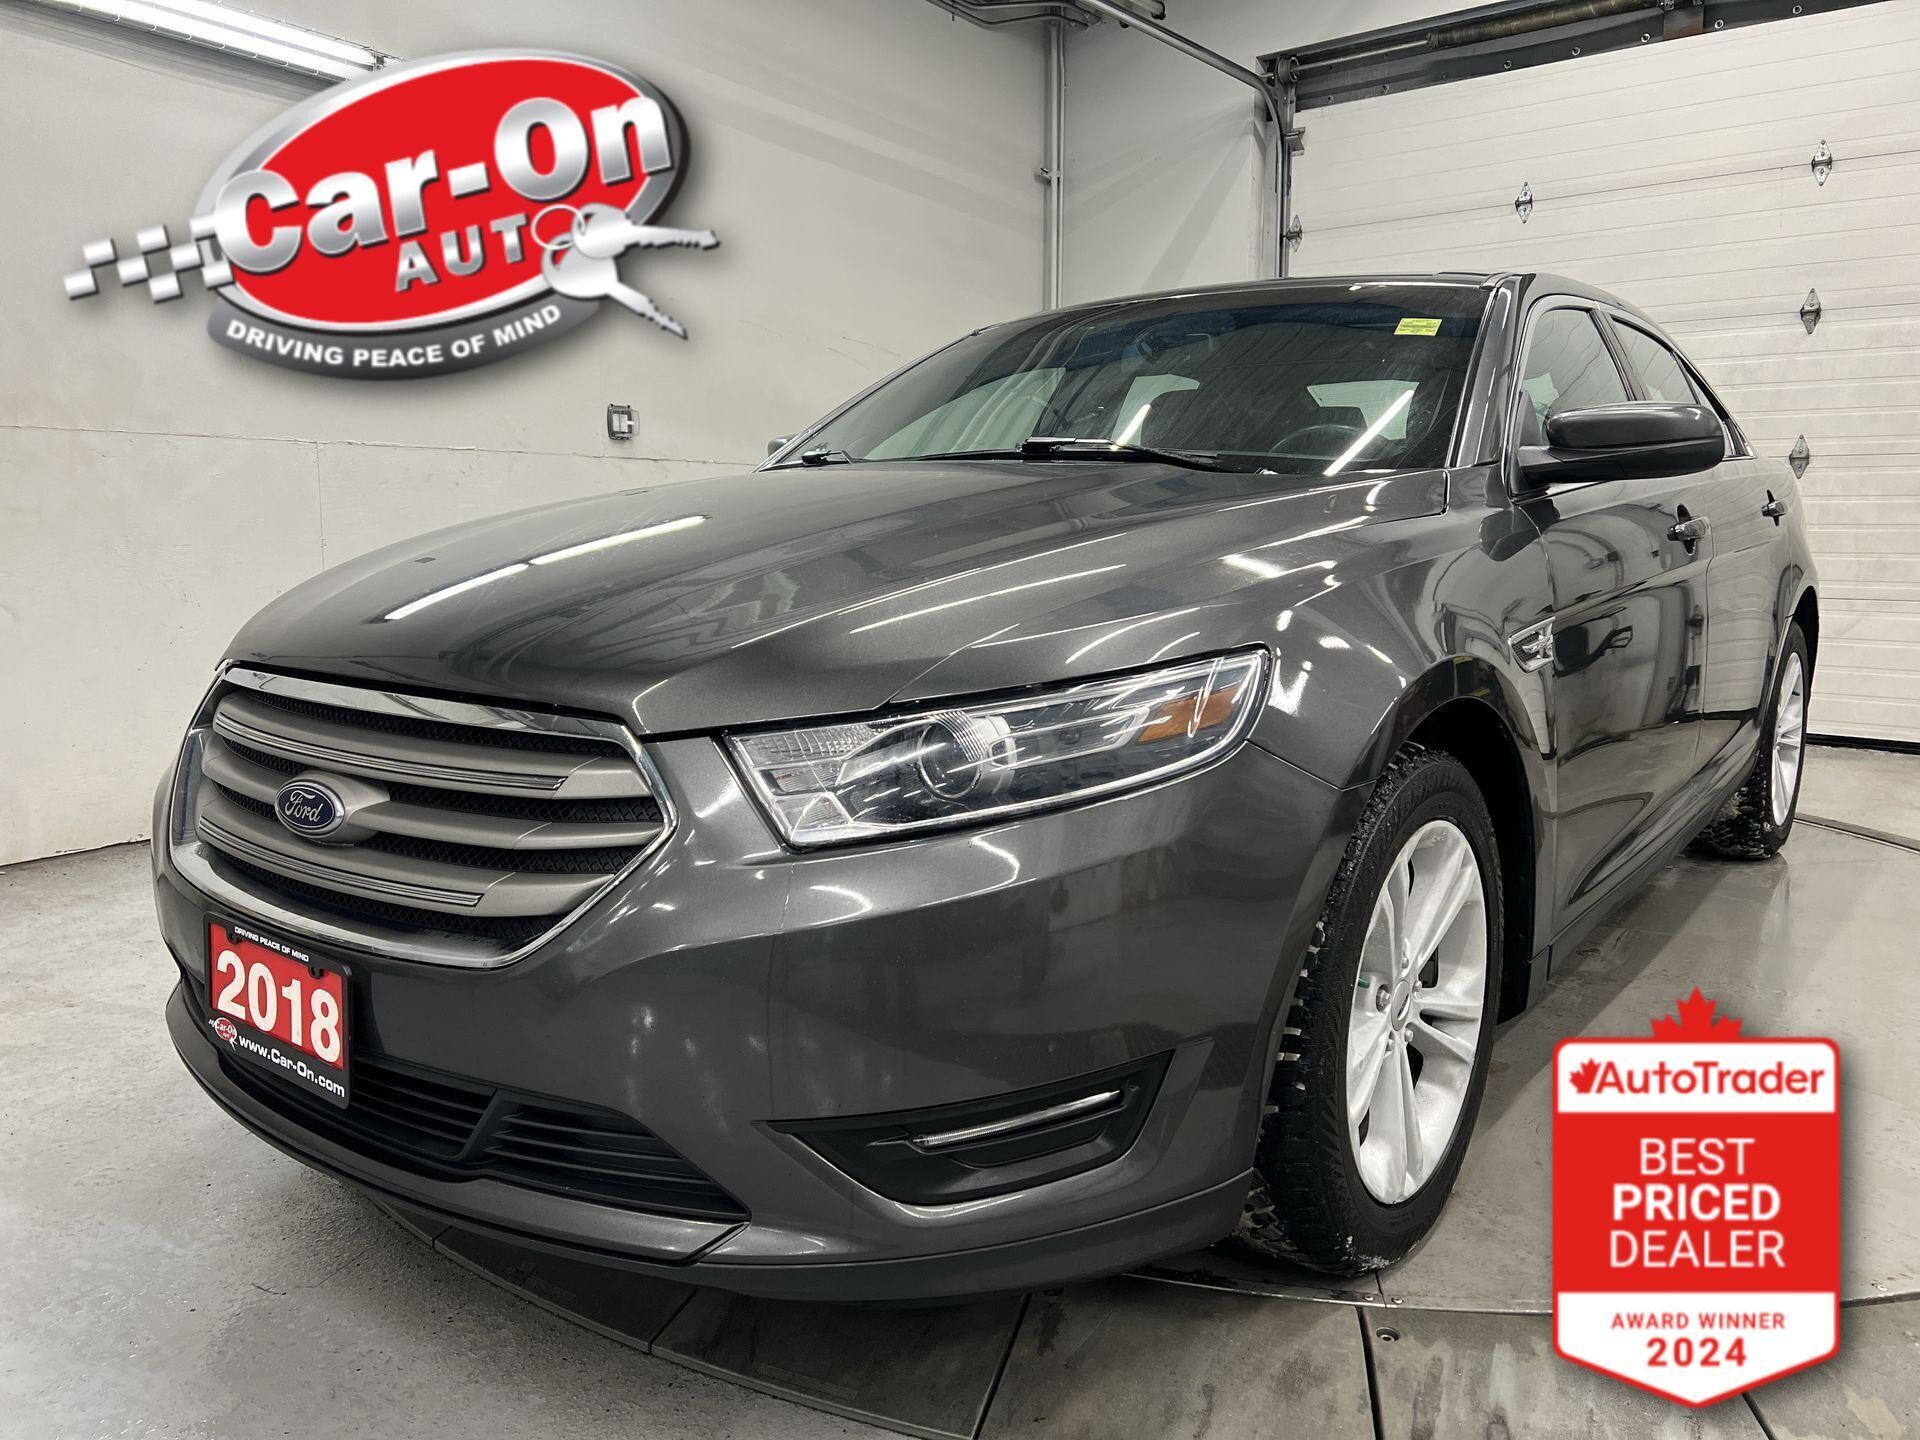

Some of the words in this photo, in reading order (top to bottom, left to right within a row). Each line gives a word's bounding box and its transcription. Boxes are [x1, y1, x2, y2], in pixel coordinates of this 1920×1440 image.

[284, 789, 324, 823] Ford
[234, 926, 260, 943] DRIVING
[260, 936, 281, 951] PEACE
[281, 945, 292, 955] OF
[291, 949, 310, 963] MIND
[217, 950, 341, 1063] 2018
[238, 1035, 346, 1098] www.Car-On.com
